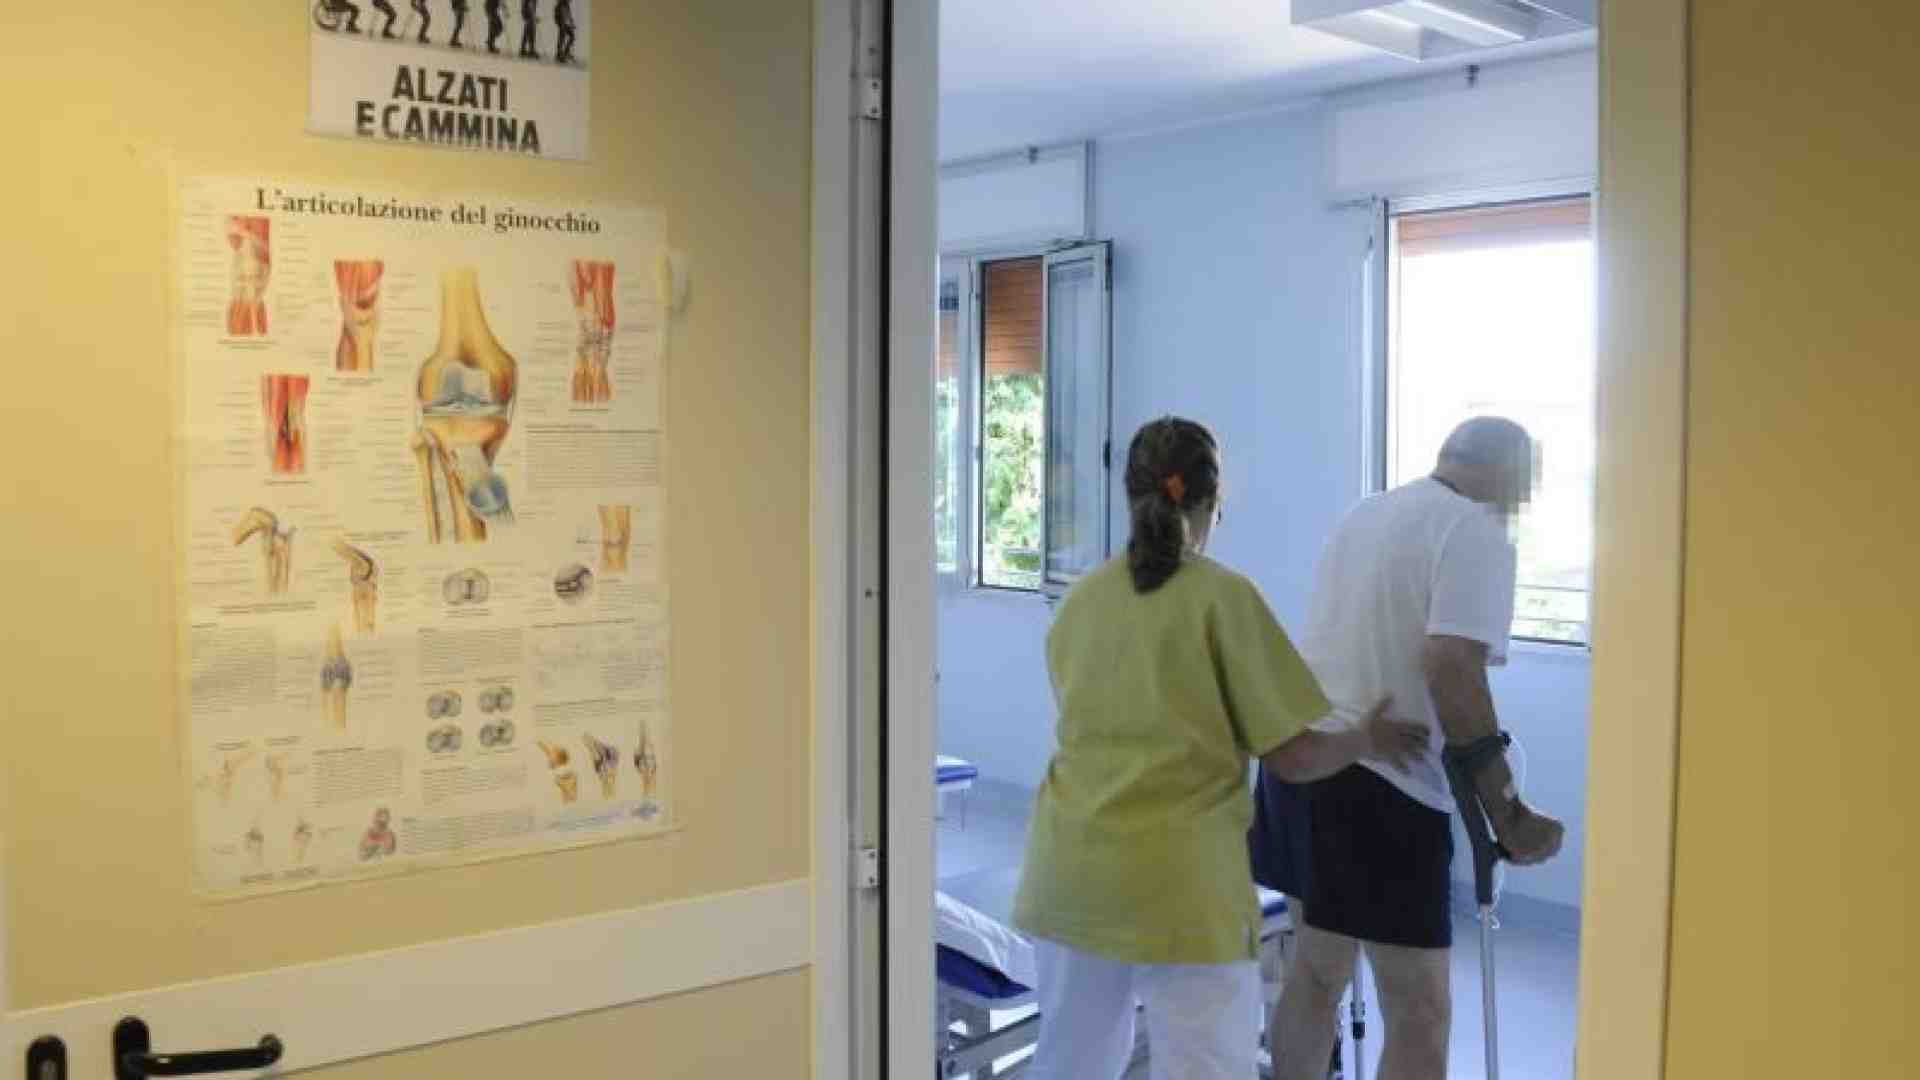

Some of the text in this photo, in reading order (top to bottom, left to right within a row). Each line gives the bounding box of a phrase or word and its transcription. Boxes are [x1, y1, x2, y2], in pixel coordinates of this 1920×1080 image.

[392, 64, 508, 112] ALZATI
[356, 101, 541, 154] E CAMMINA
[256, 188, 601, 234] L'articolazione del ginocchio
